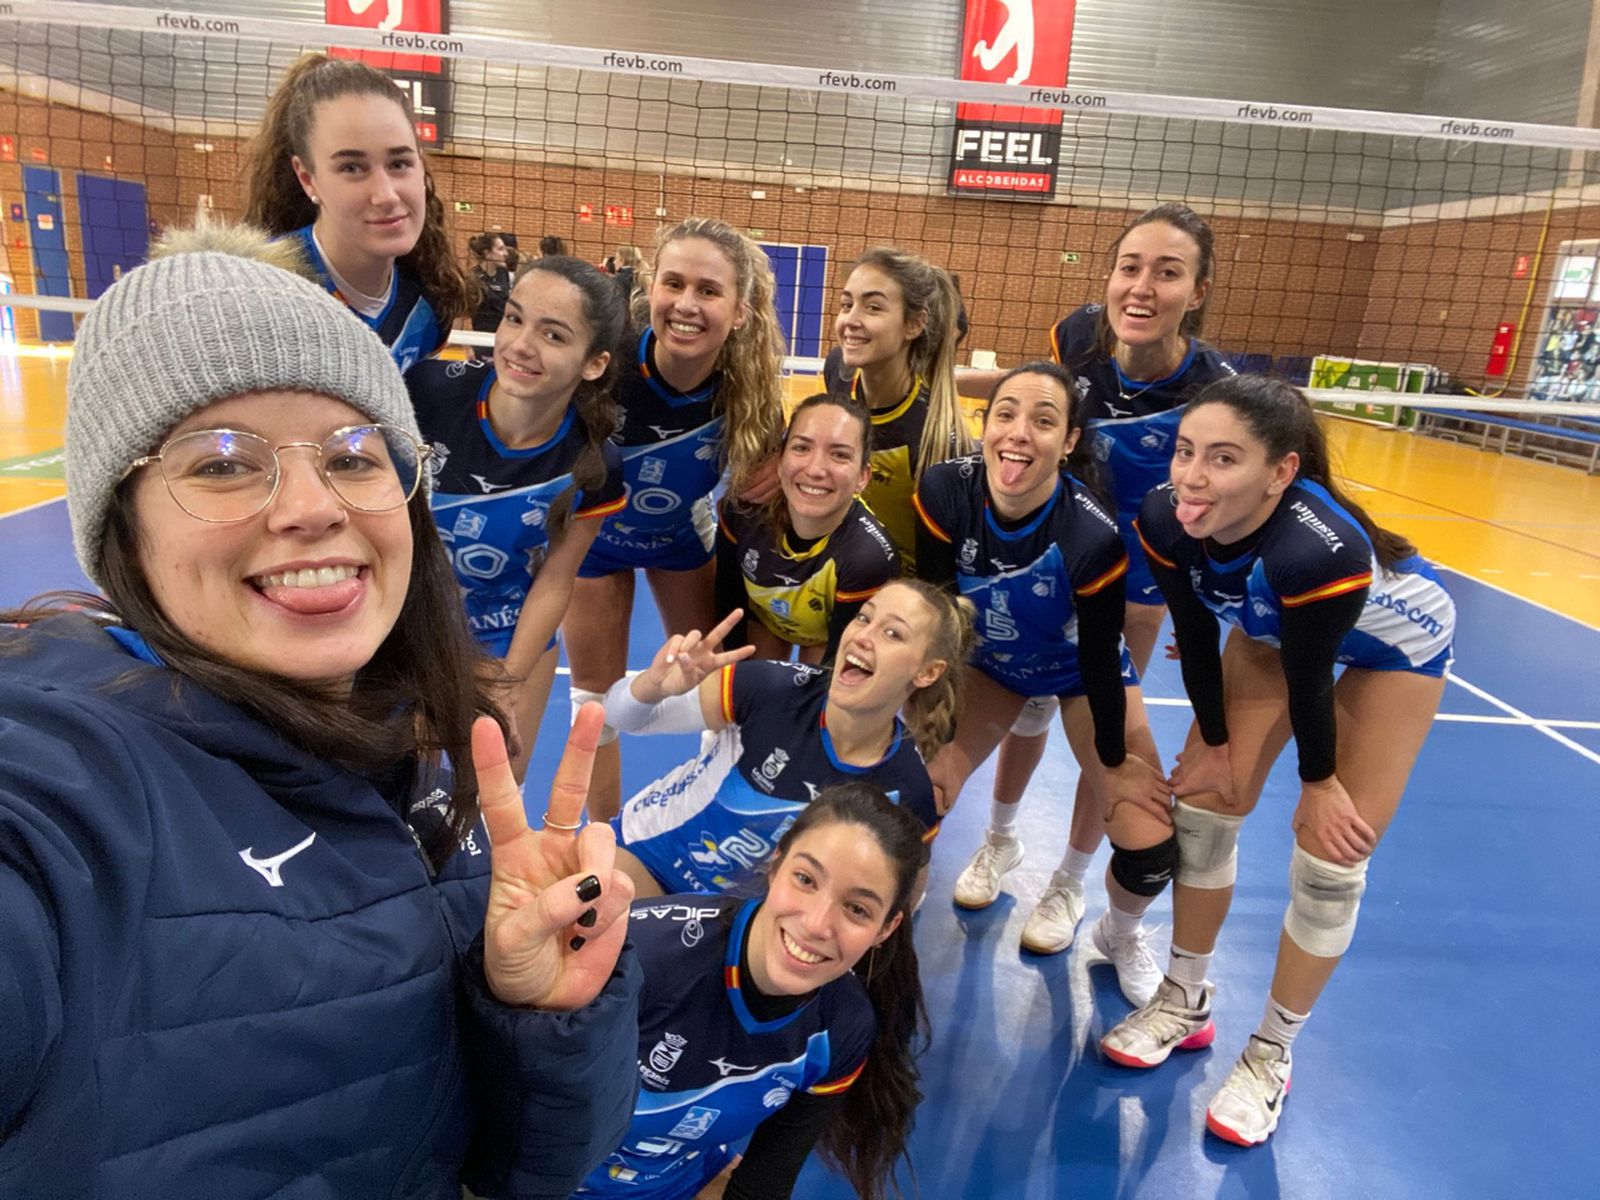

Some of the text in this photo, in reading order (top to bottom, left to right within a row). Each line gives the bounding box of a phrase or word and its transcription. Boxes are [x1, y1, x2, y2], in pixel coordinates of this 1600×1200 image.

[156, 14, 240, 33] rfevb.com
[381, 33, 464, 53] rfevb.com
[603, 53, 683, 73] rfevb.com
[818, 71, 897, 91] rfevb.com
[1029, 89, 1106, 107] rfevb.com
[1237, 104, 1313, 122] rfevb.com
[1440, 121, 1514, 139] rfevb.com
[958, 174, 1046, 187] ALCOBENDAS
